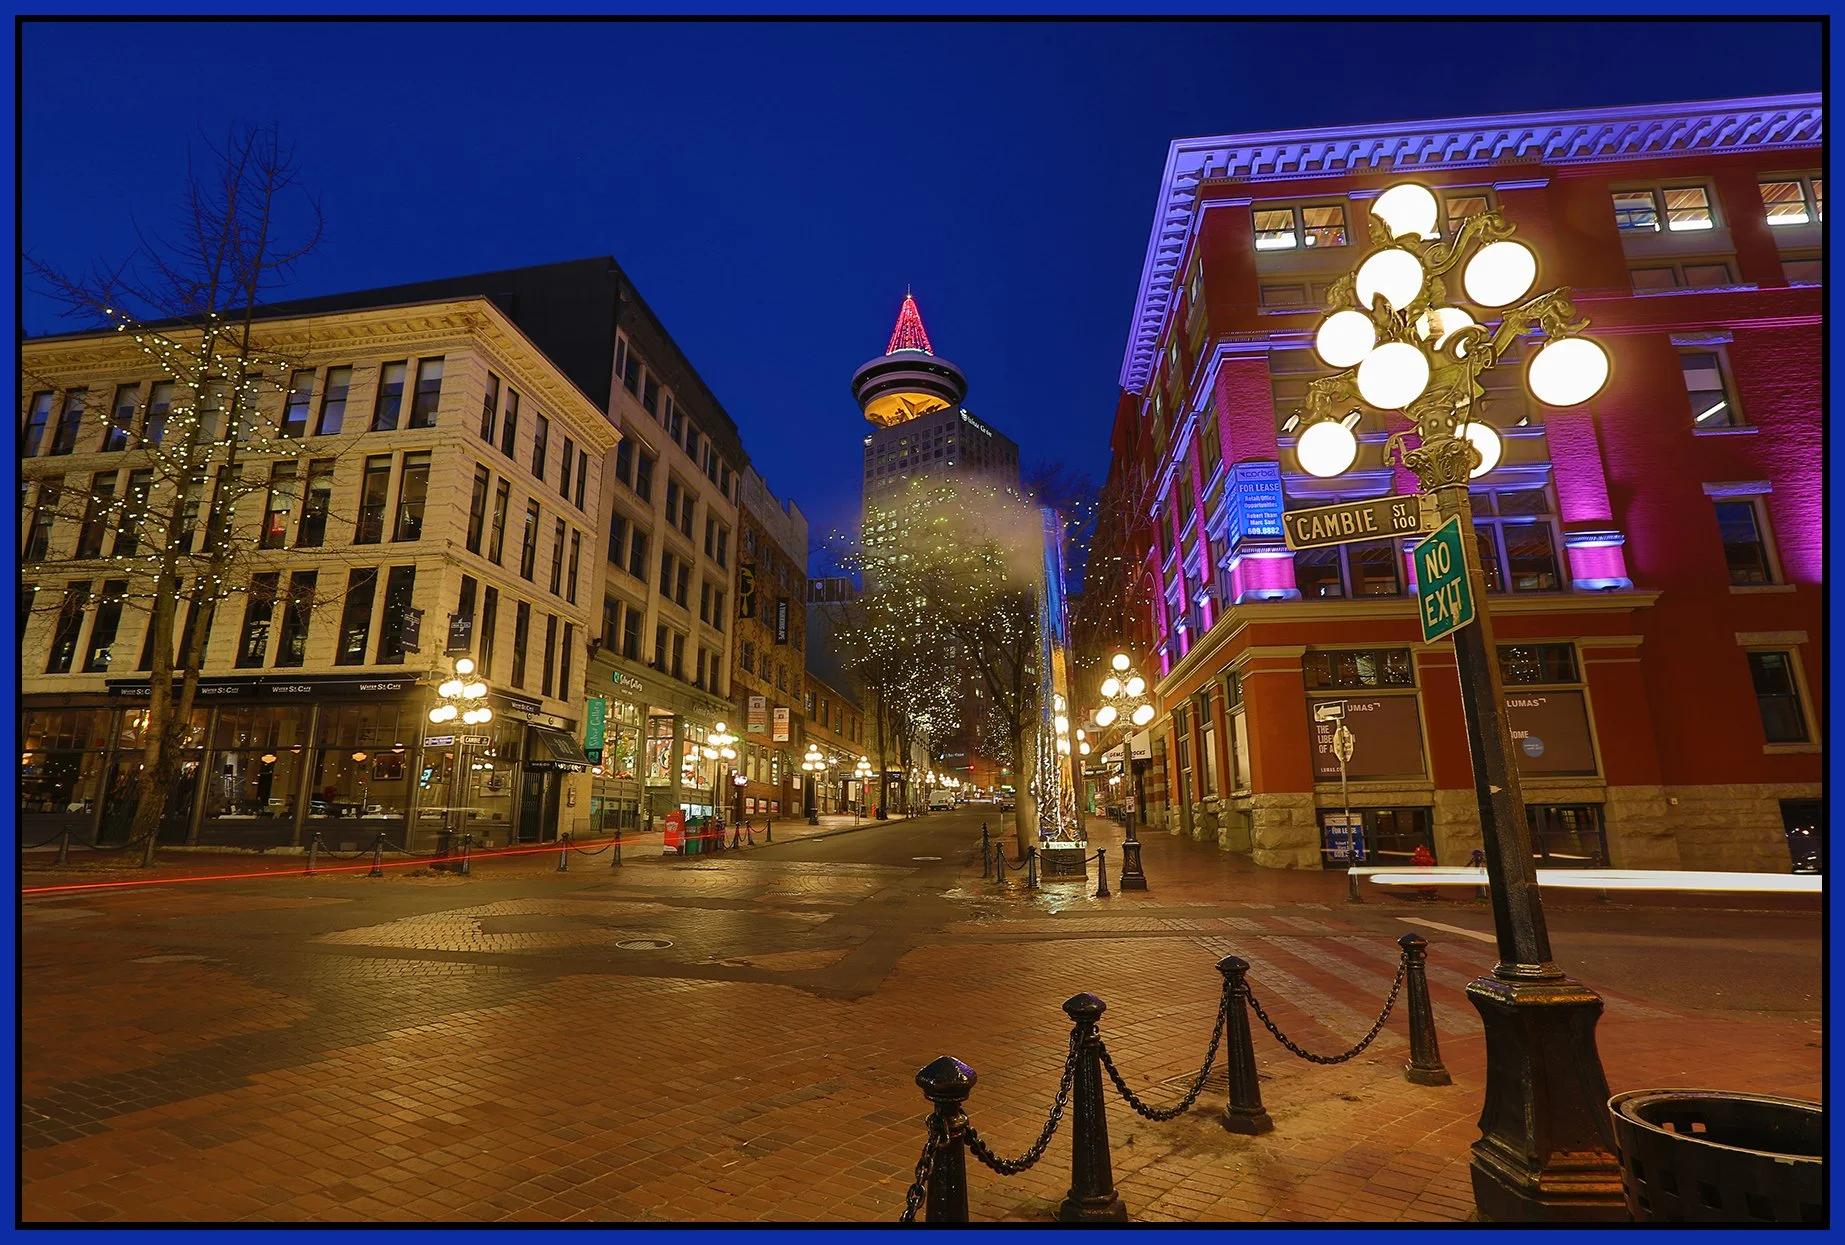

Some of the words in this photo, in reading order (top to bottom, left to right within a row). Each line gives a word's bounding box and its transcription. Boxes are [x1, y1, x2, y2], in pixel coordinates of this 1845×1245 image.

[1240, 484, 1254, 492] FOR
[1255, 483, 1280, 492] LEASE
[1392, 503, 1406, 517] ST
[1296, 508, 1378, 541] CAMBIE
[1392, 515, 1416, 530] 100
[1425, 541, 1451, 584] NO
[1424, 576, 1462, 627] EXIT
[1347, 703, 1374, 712] UMAS
[1506, 699, 1540, 707] LUMAS
[1316, 725, 1330, 734] THE
